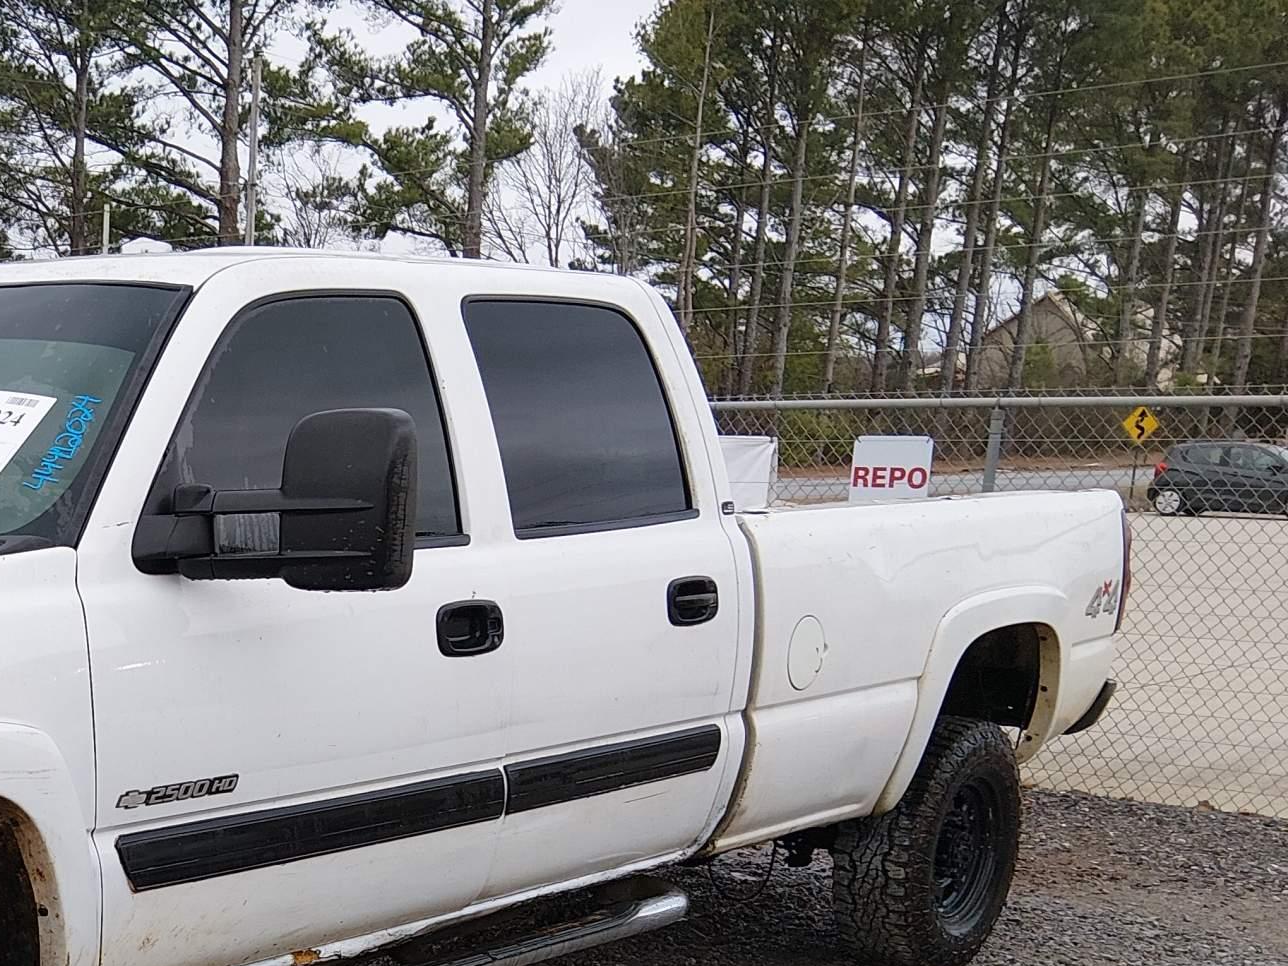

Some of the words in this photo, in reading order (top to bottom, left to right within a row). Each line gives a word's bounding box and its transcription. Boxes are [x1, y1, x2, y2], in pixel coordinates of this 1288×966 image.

[22, 393, 102, 490] 44412024
[852, 466, 928, 490] REPO
[148, 779, 211, 804] 2500
[211, 776, 238, 793] HD
